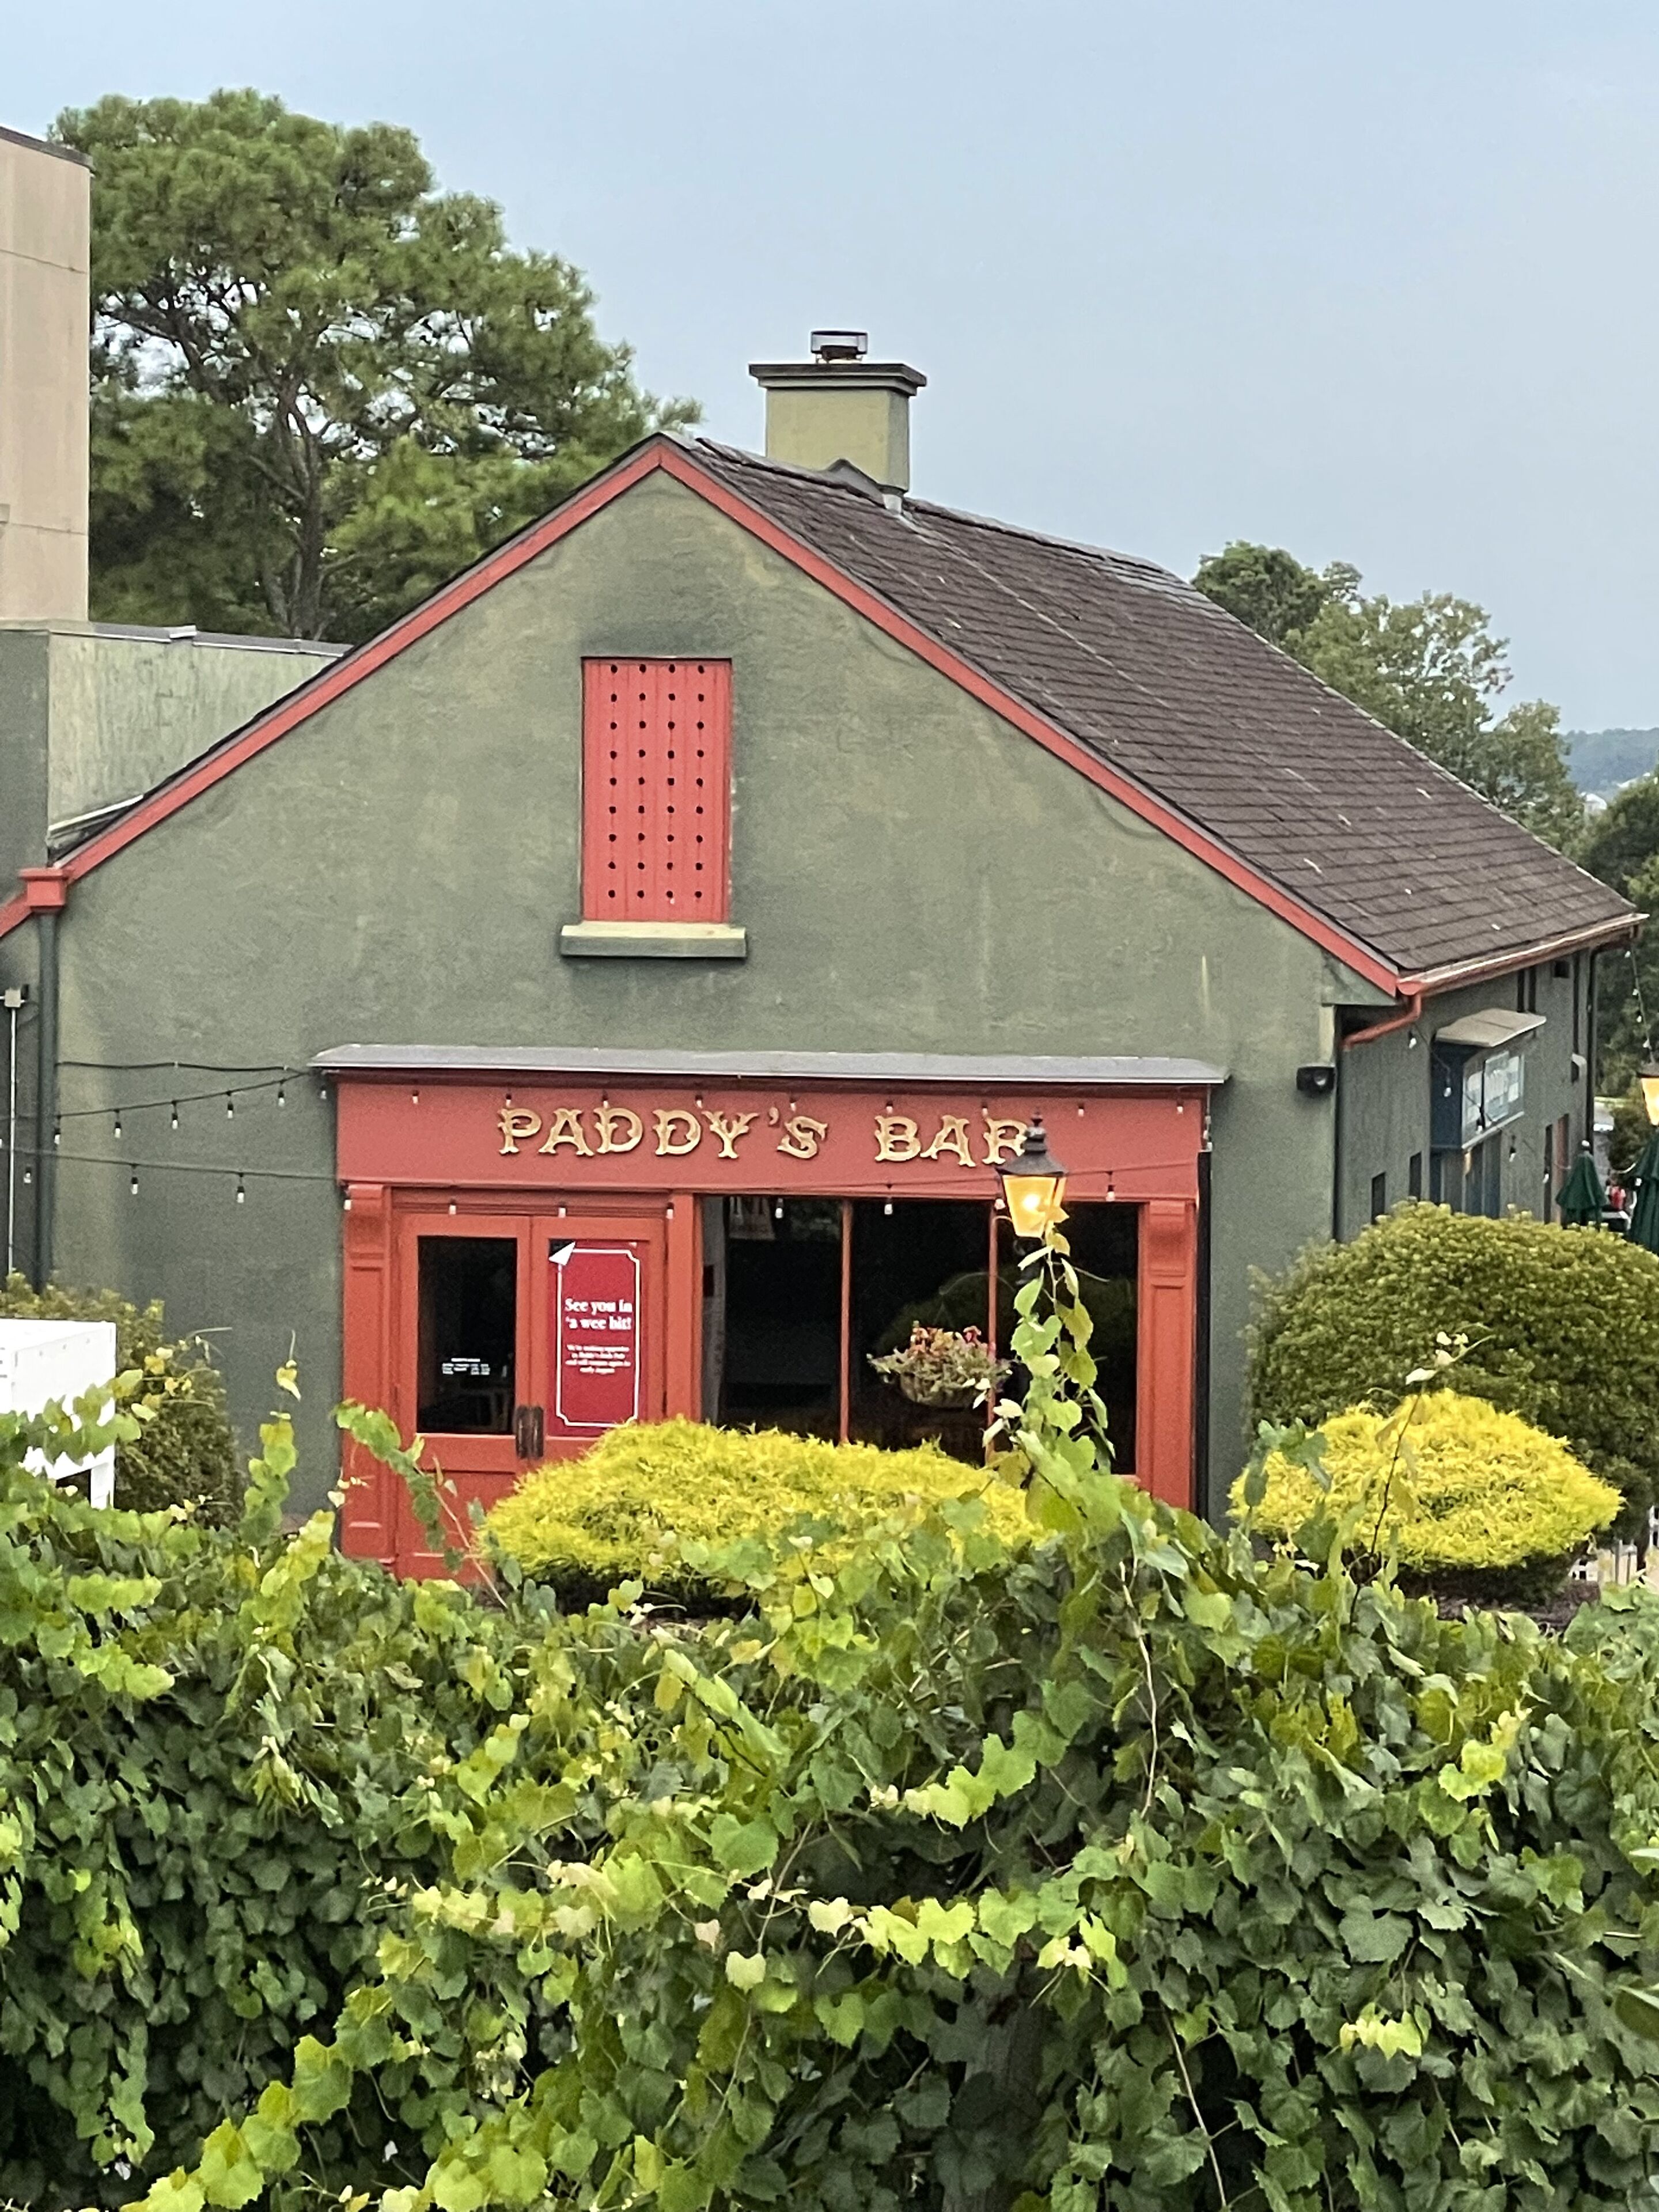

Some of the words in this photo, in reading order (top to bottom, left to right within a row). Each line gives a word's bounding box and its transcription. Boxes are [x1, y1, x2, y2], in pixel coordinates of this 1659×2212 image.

[498, 1107, 828, 1159] PADDY'S
[874, 1115, 1027, 1167] BAR
[565, 1298, 588, 1312] See
[590, 1301, 616, 1316] you
[619, 1299, 632, 1312] in
[579, 1319, 607, 1330] wee
